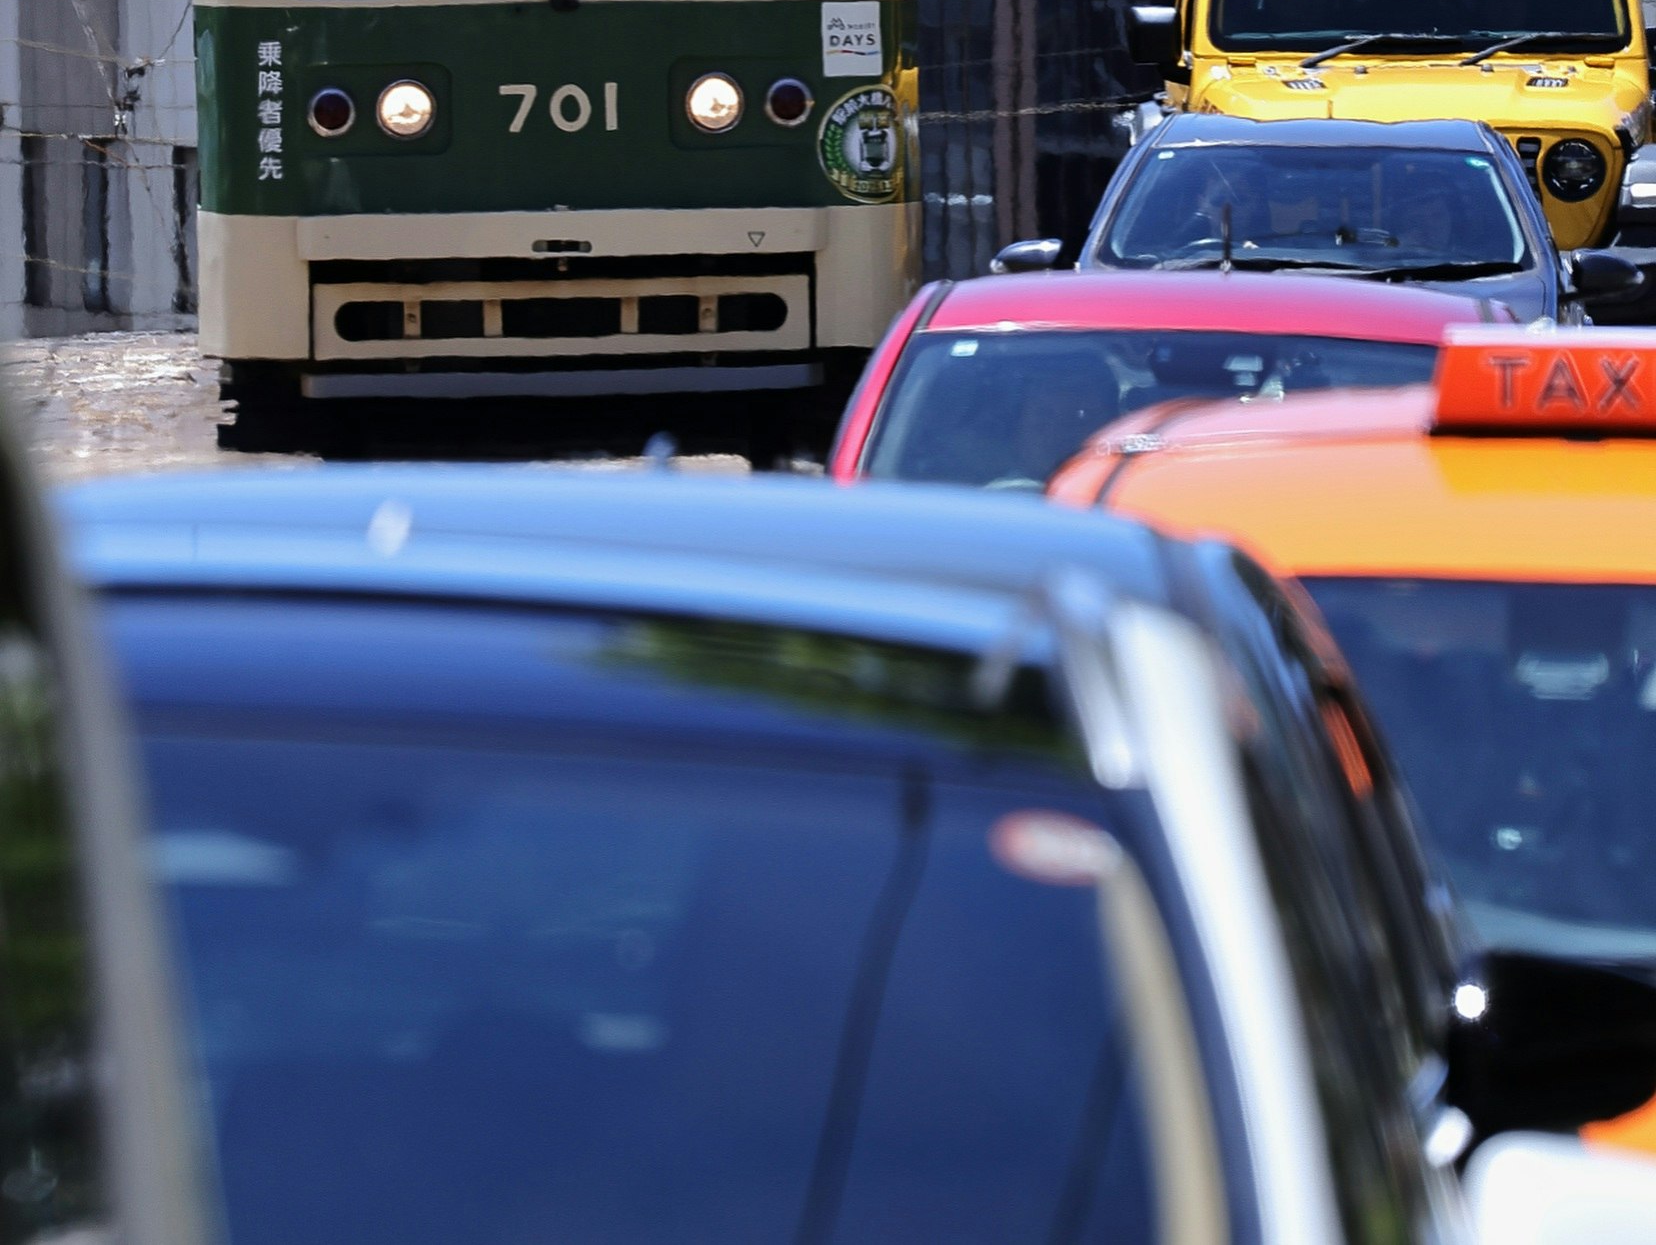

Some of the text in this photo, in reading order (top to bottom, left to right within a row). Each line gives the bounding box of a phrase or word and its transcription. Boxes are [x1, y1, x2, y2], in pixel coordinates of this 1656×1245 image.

[829, 34, 876, 47] DAYS
[257, 41, 283, 180] 乗降者優先
[499, 82, 618, 132] 701
[1486, 351, 1642, 411] TAX
